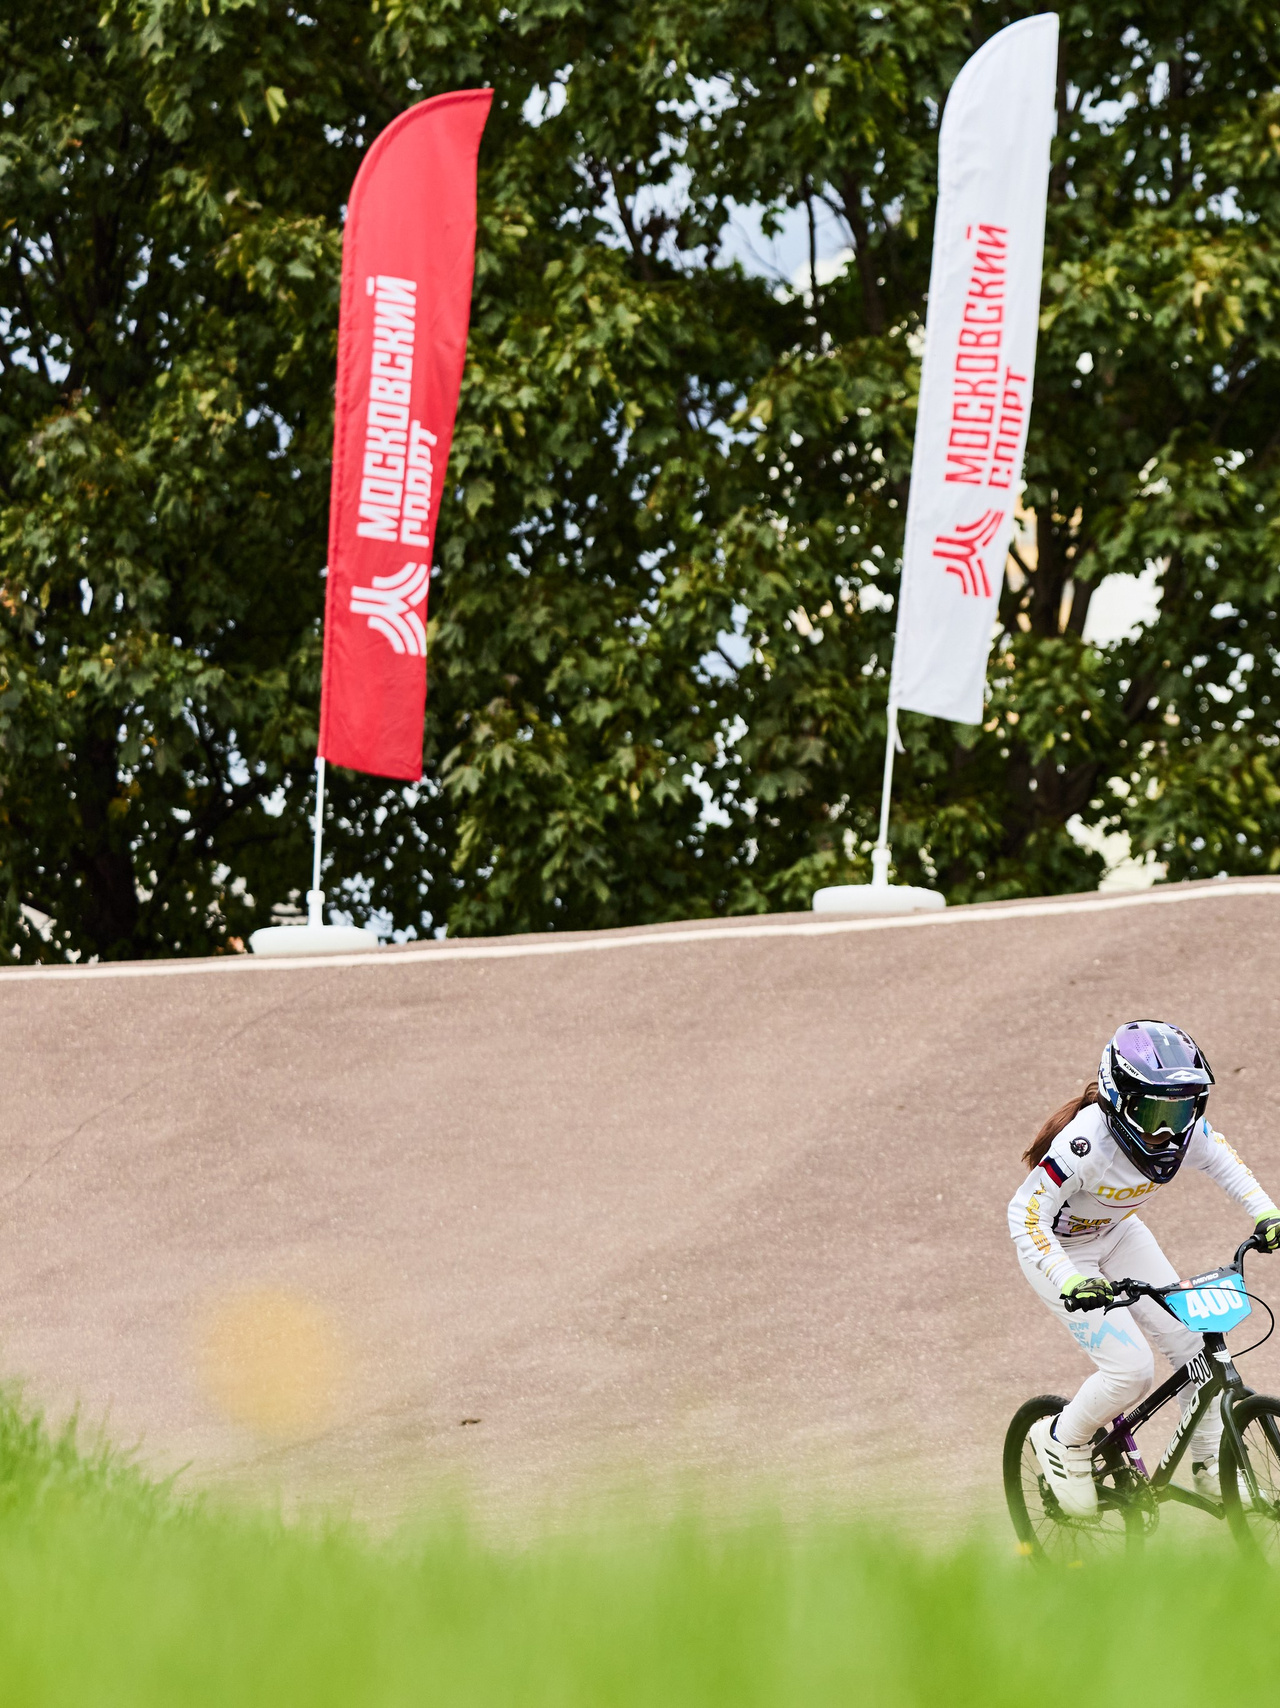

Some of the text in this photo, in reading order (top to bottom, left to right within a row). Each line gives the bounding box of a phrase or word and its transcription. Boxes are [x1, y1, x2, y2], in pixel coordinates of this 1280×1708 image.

[945, 223, 1009, 486] МОСКОВСКИЙ
[357, 275, 417, 542] МОСКОВСКИЙ
[1185, 1279, 1243, 1319] 400
[1187, 1352, 1212, 1386] 400
[1160, 1389, 1200, 1470] MEYBO
